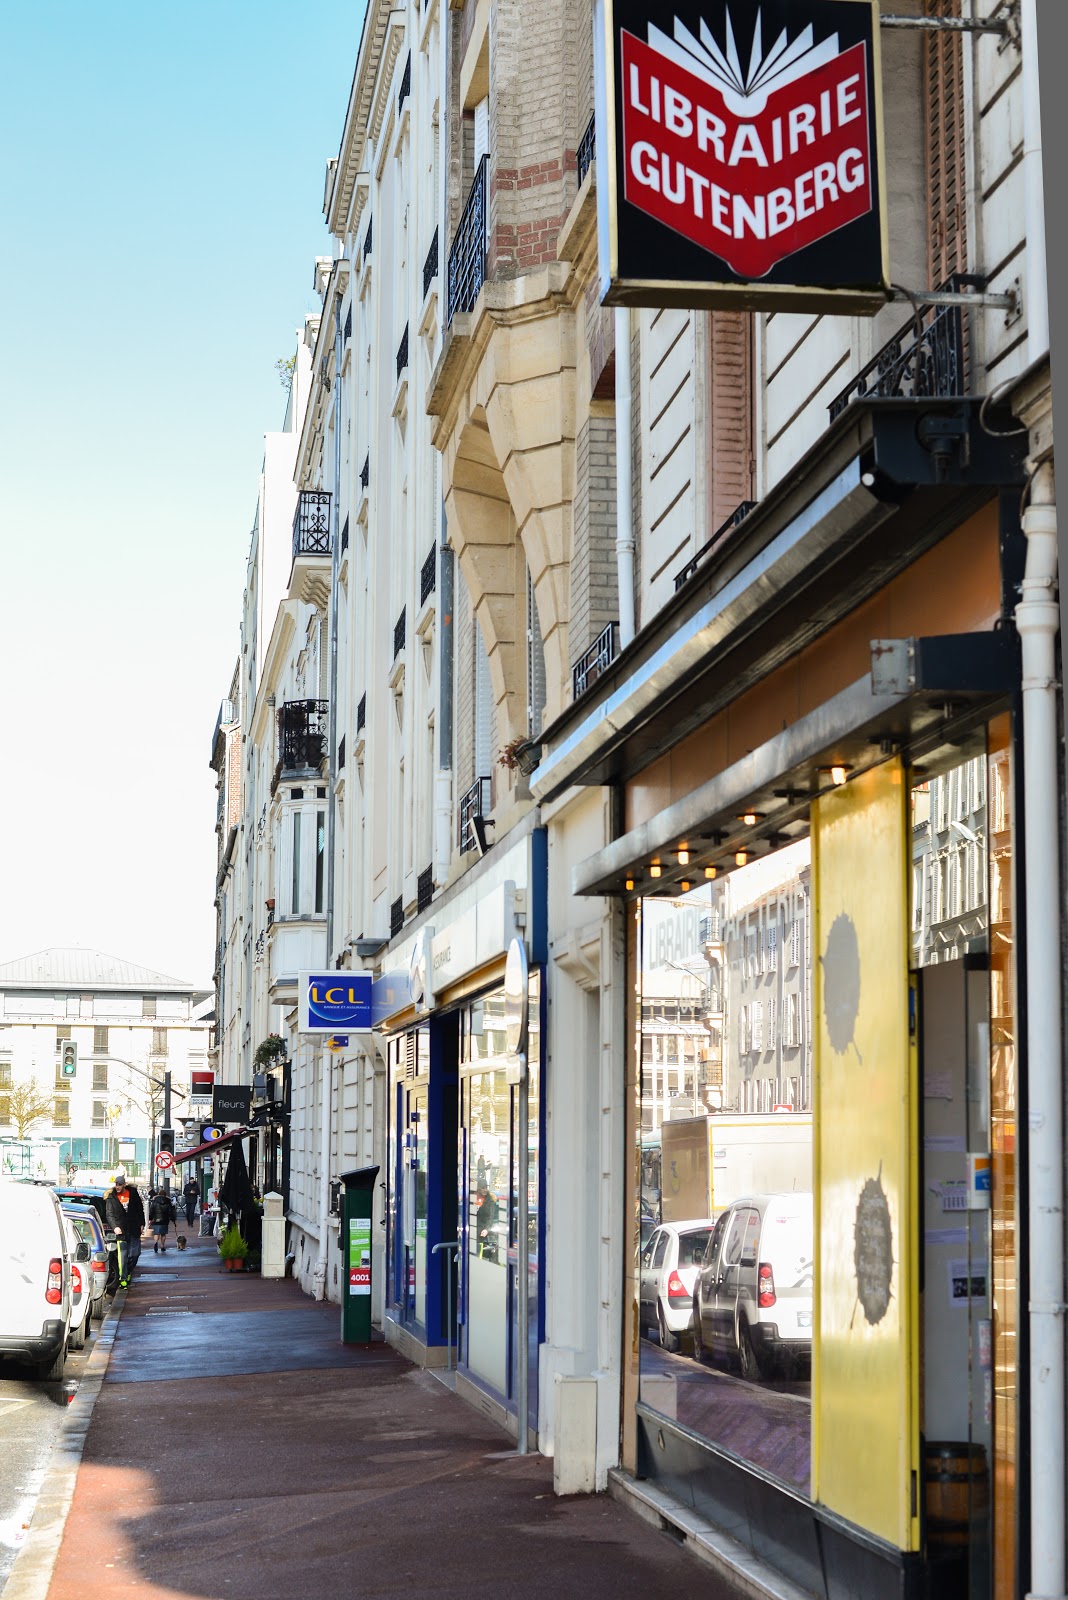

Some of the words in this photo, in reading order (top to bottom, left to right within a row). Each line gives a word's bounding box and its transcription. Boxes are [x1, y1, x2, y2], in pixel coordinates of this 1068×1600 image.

[630, 62, 861, 168] LIBRAIRIE
[630, 141, 865, 240] GUTENBERG
[312, 987, 364, 1005] LCL
[218, 1100, 245, 1109] fleurs
